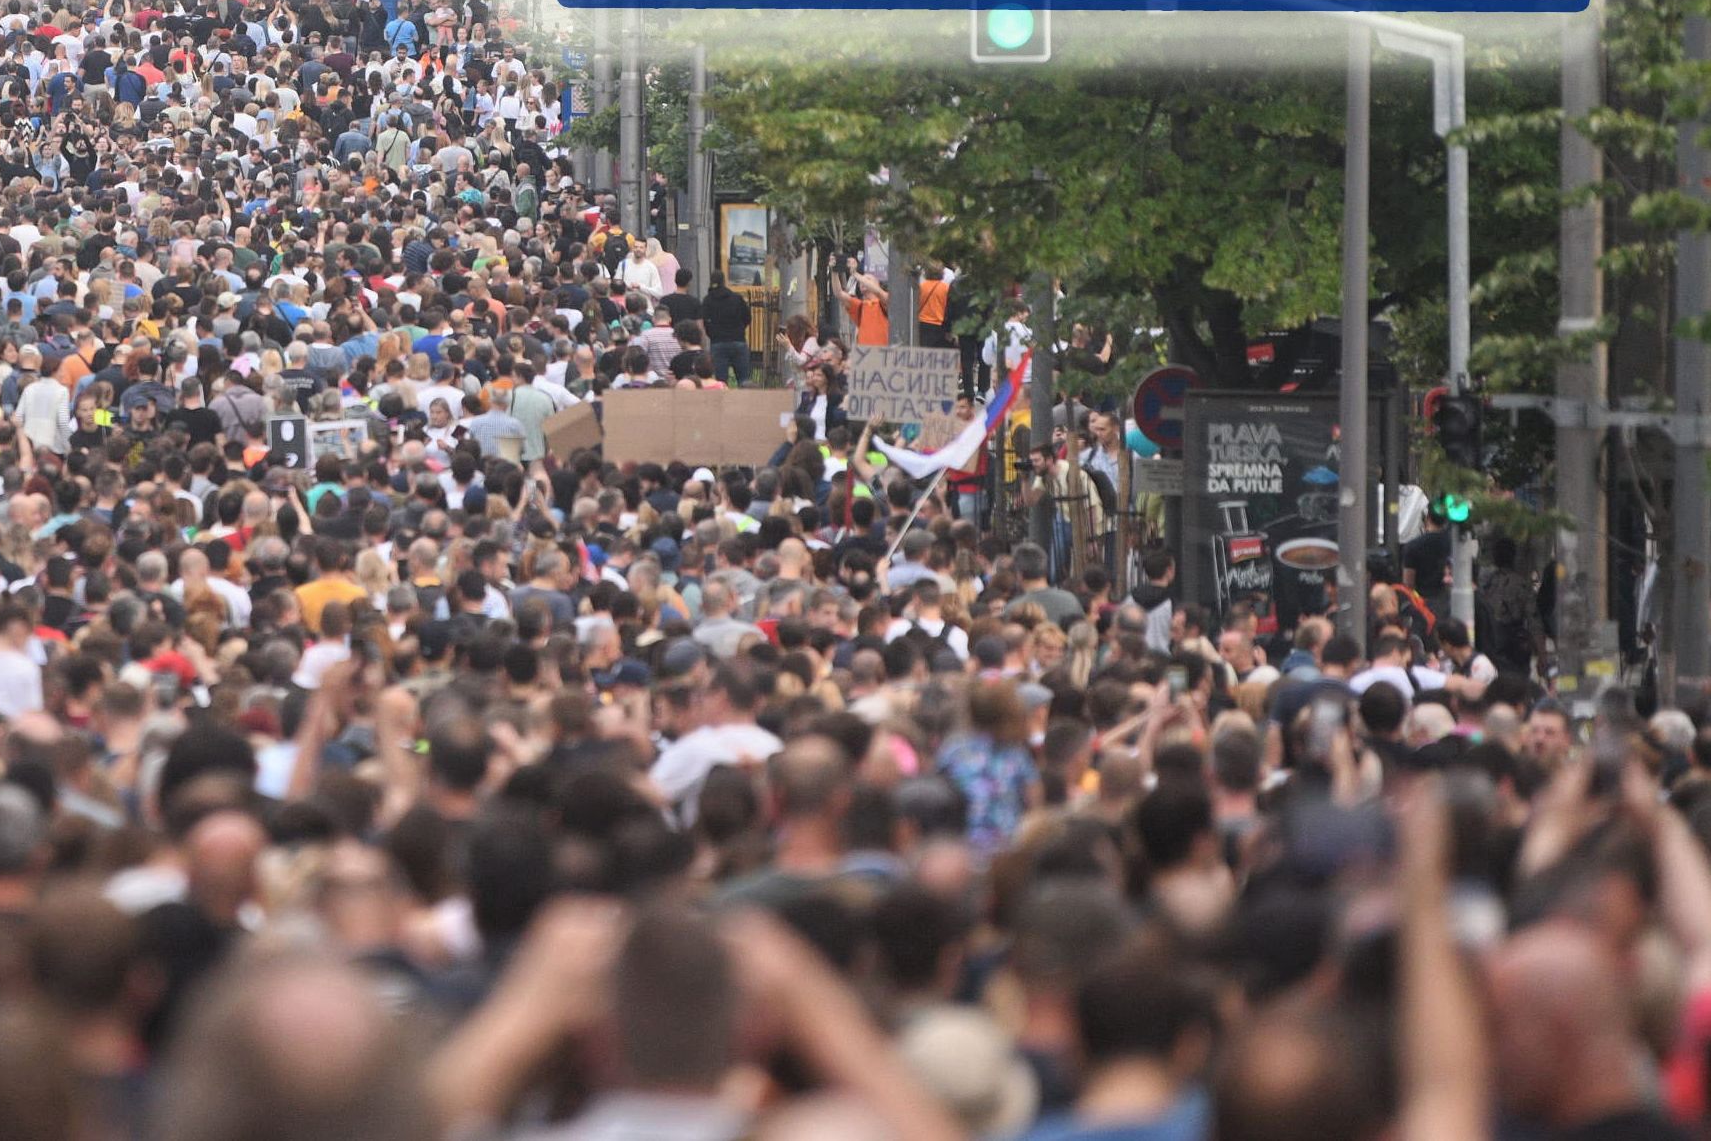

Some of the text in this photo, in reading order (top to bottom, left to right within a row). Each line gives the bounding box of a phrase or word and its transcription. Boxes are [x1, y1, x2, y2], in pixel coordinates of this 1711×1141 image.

[856, 347, 961, 369] У ТИШИНИ
[853, 371, 954, 396] НАСИЉЕ
[1208, 423, 1283, 444] PRAVA
[1208, 463, 1282, 478] SPREMNA
[1208, 479, 1283, 493] DA PUTUJE
